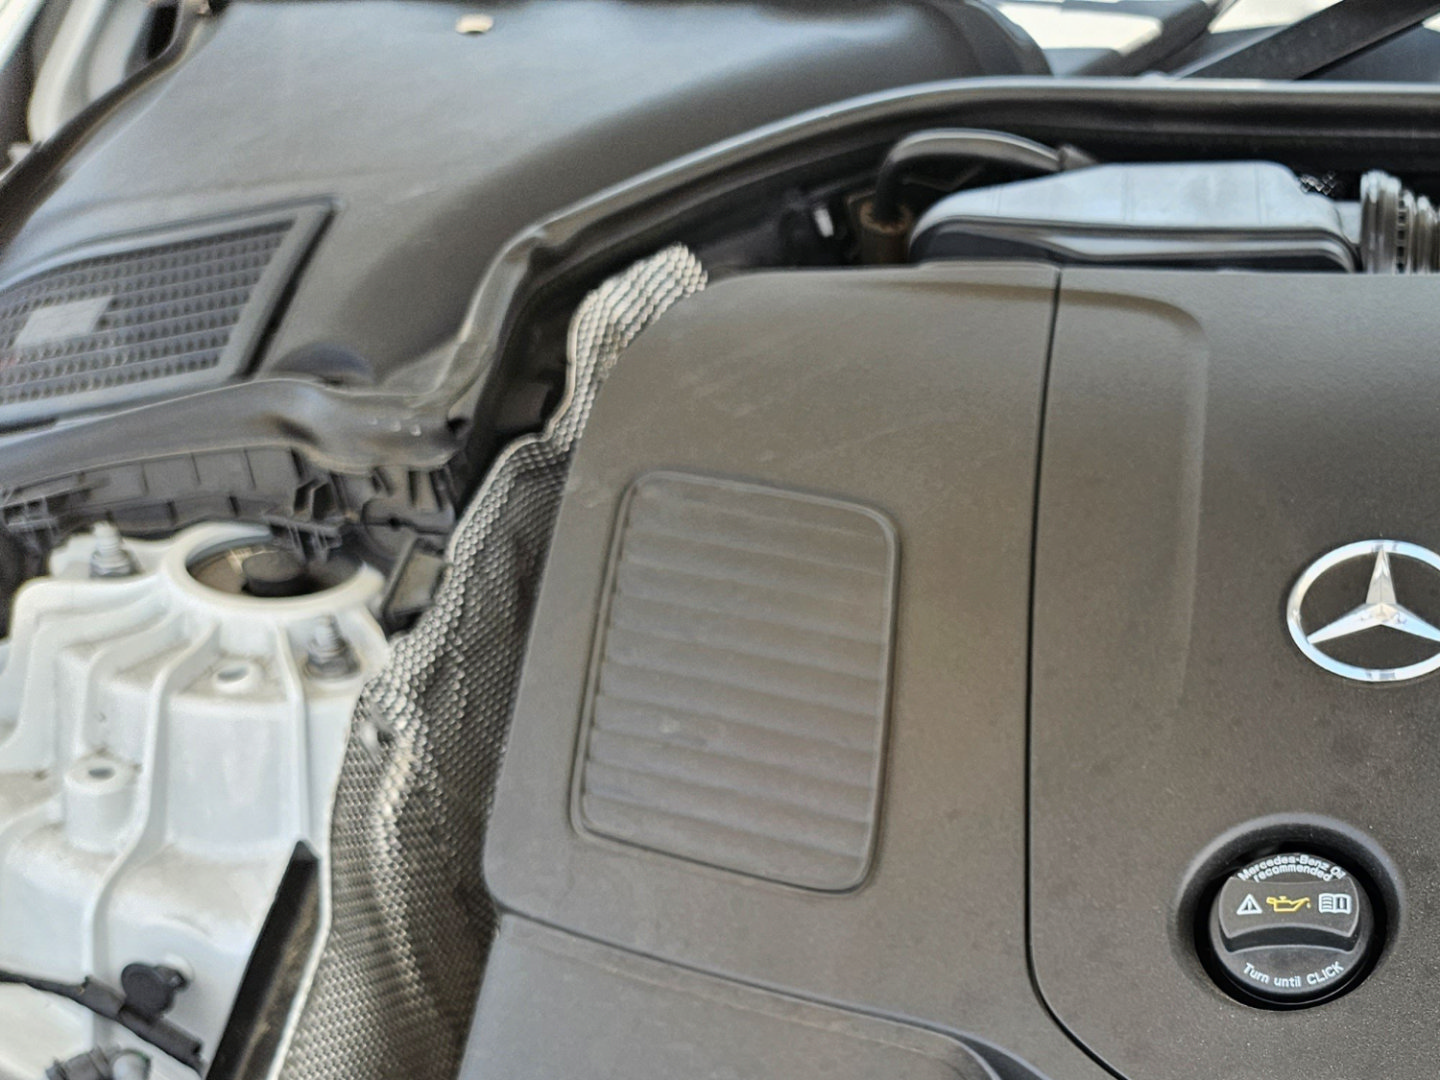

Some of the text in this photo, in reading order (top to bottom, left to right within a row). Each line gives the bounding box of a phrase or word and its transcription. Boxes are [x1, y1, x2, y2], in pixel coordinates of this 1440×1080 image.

[1237, 854, 1330, 881] Mercedes-Benz
[1253, 864, 1333, 883] recommended
[1243, 960, 1345, 987] Turn until CLICK
